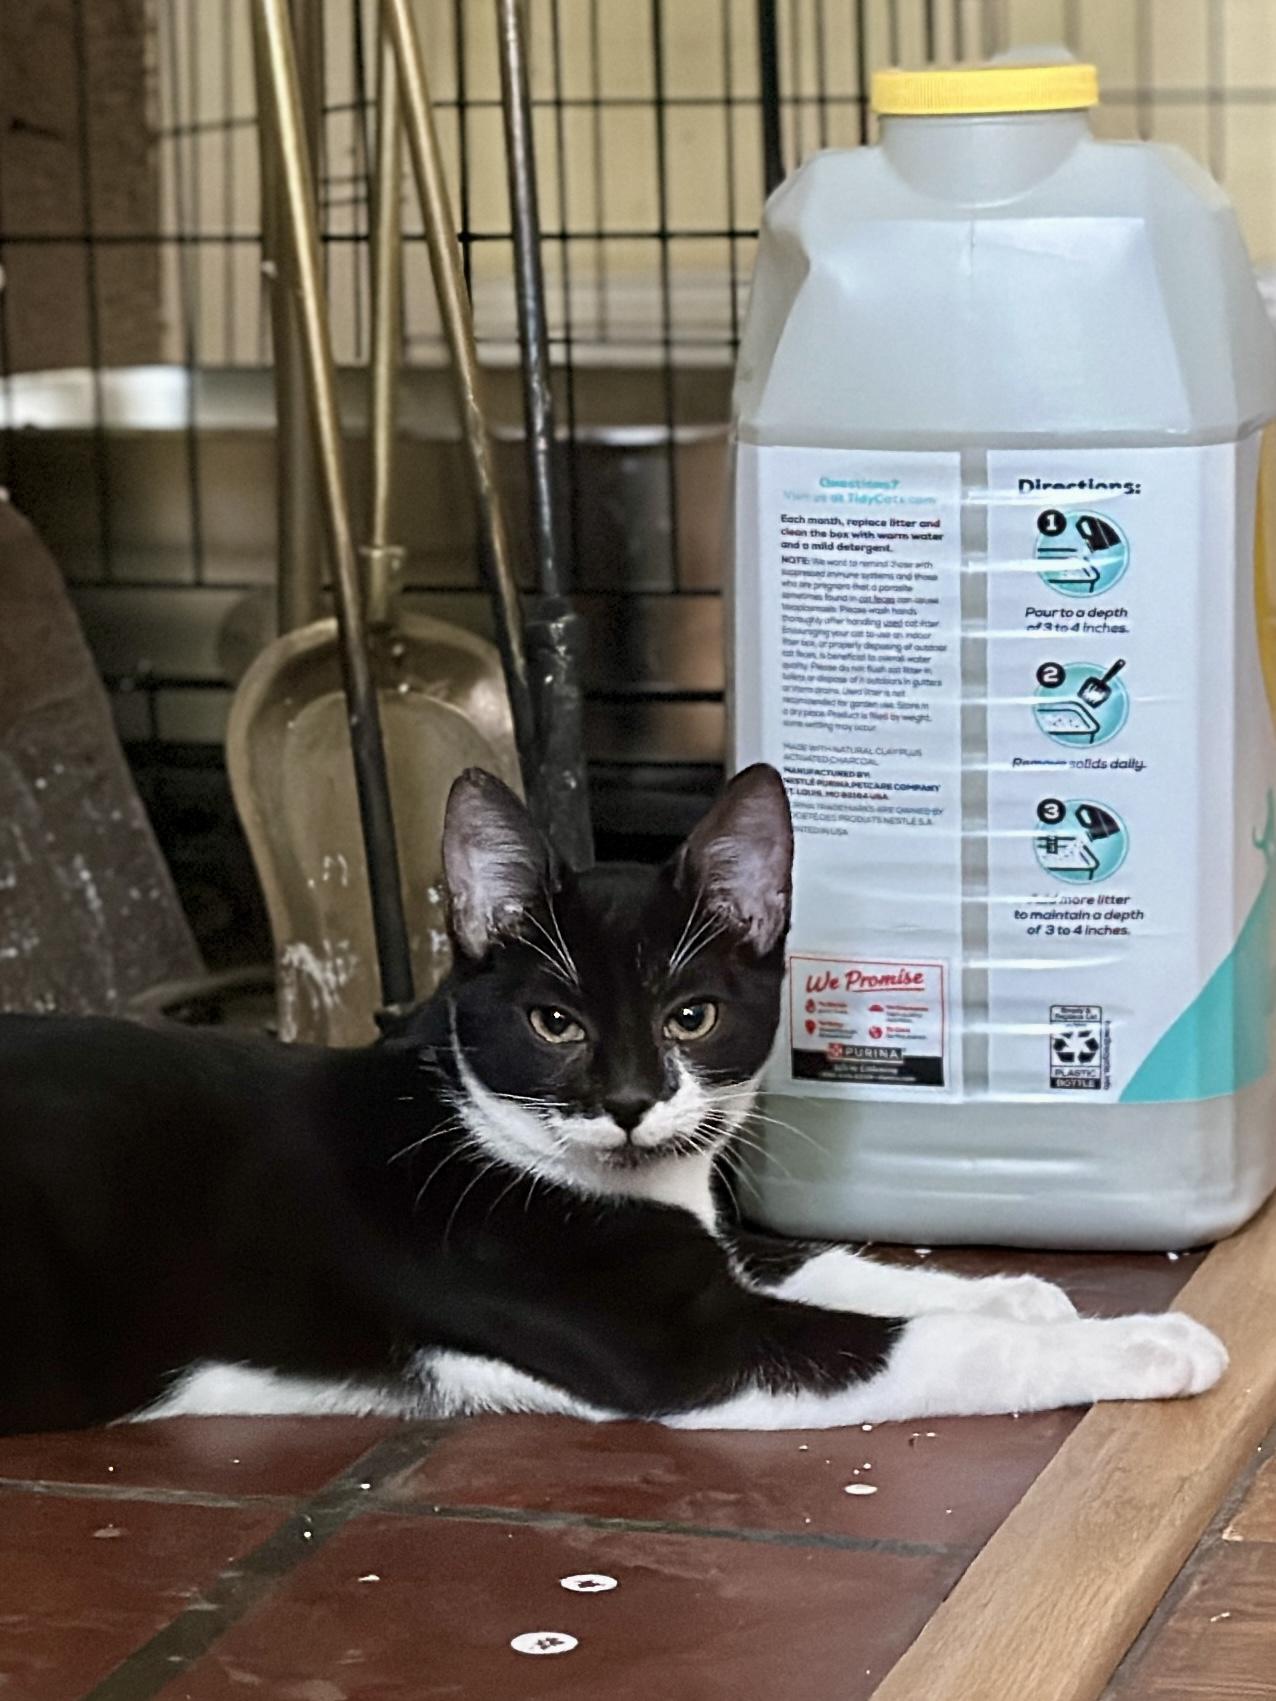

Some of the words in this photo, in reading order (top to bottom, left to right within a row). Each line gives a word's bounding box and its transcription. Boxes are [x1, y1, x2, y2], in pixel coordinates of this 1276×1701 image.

[1018, 479, 1141, 495] Directions:
[781, 514, 805, 524] Each
[807, 517, 845, 526] month,
[847, 518, 887, 528] replace
[889, 518, 915, 527] litter
[919, 520, 940, 528] and
[1046, 514, 1057, 530] 1
[781, 528, 807, 537] clean
[810, 529, 827, 538] the
[829, 530, 849, 538] box
[851, 531, 875, 539] with
[911, 533, 944, 541] water
[781, 541, 799, 549] and
[811, 542, 834, 550] mild
[836, 544, 893, 554] detergent.
[1025, 607, 1058, 618] Pour
[1060, 608, 1074, 617] to
[1076, 610, 1085, 618] a
[1087, 608, 1128, 621] depth
[1070, 623, 1080, 632] 4
[1083, 623, 1129, 633] inches.
[1043, 666, 1058, 682] 2
[1069, 758, 1107, 769] solids
[1110, 758, 1146, 772] daily.
[1044, 804, 1059, 819] 3
[1059, 896, 1095, 905] more
[1098, 895, 1131, 904] litter
[1014, 910, 1028, 919] to
[1030, 911, 1090, 920] maintain
[1093, 911, 1102, 920] a
[1104, 910, 1144, 922] depth
[1027, 926, 1041, 935] of
[1045, 926, 1054, 935] 3
[1058, 926, 1071, 935] to
[1073, 926, 1082, 935] 4
[1085, 926, 1130, 935] inches.
[805, 971, 839, 993] We
[845, 969, 924, 991] Promise
[845, 1047, 898, 1059] PURINA
[1055, 1069, 1096, 1077] PLASTIC
